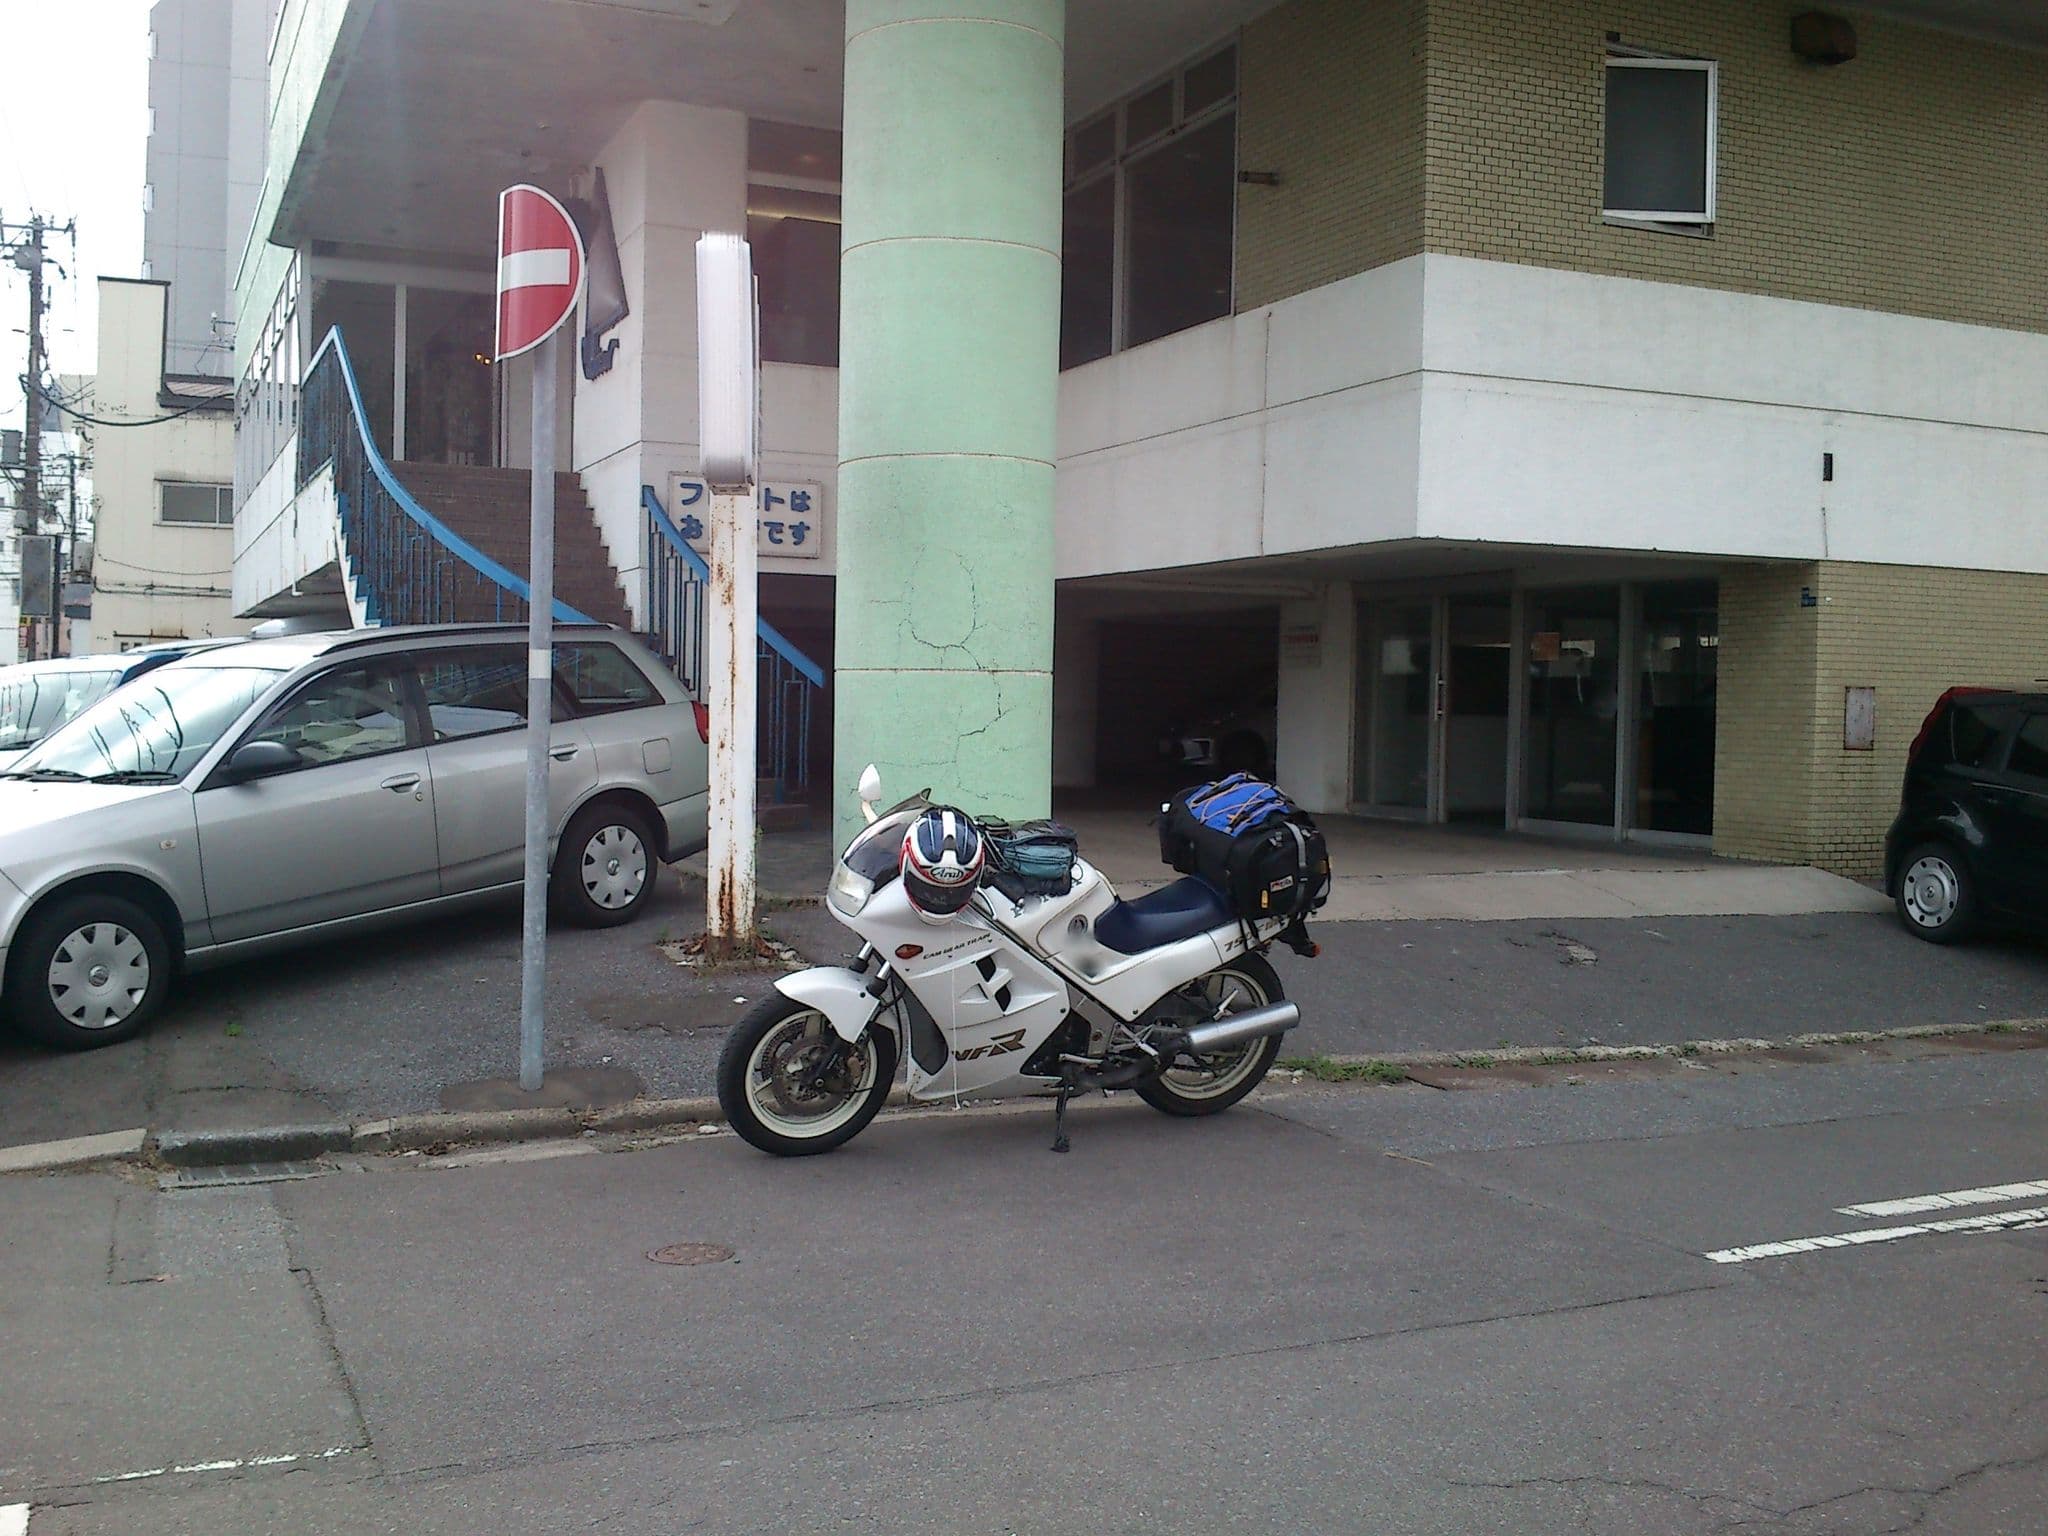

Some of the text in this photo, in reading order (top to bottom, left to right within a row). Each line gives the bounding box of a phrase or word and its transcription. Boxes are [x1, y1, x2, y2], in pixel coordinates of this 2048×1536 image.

[680, 482, 811, 513] フトは
[680, 514, 811, 546] おです
[951, 1028, 1027, 1062] VFR
